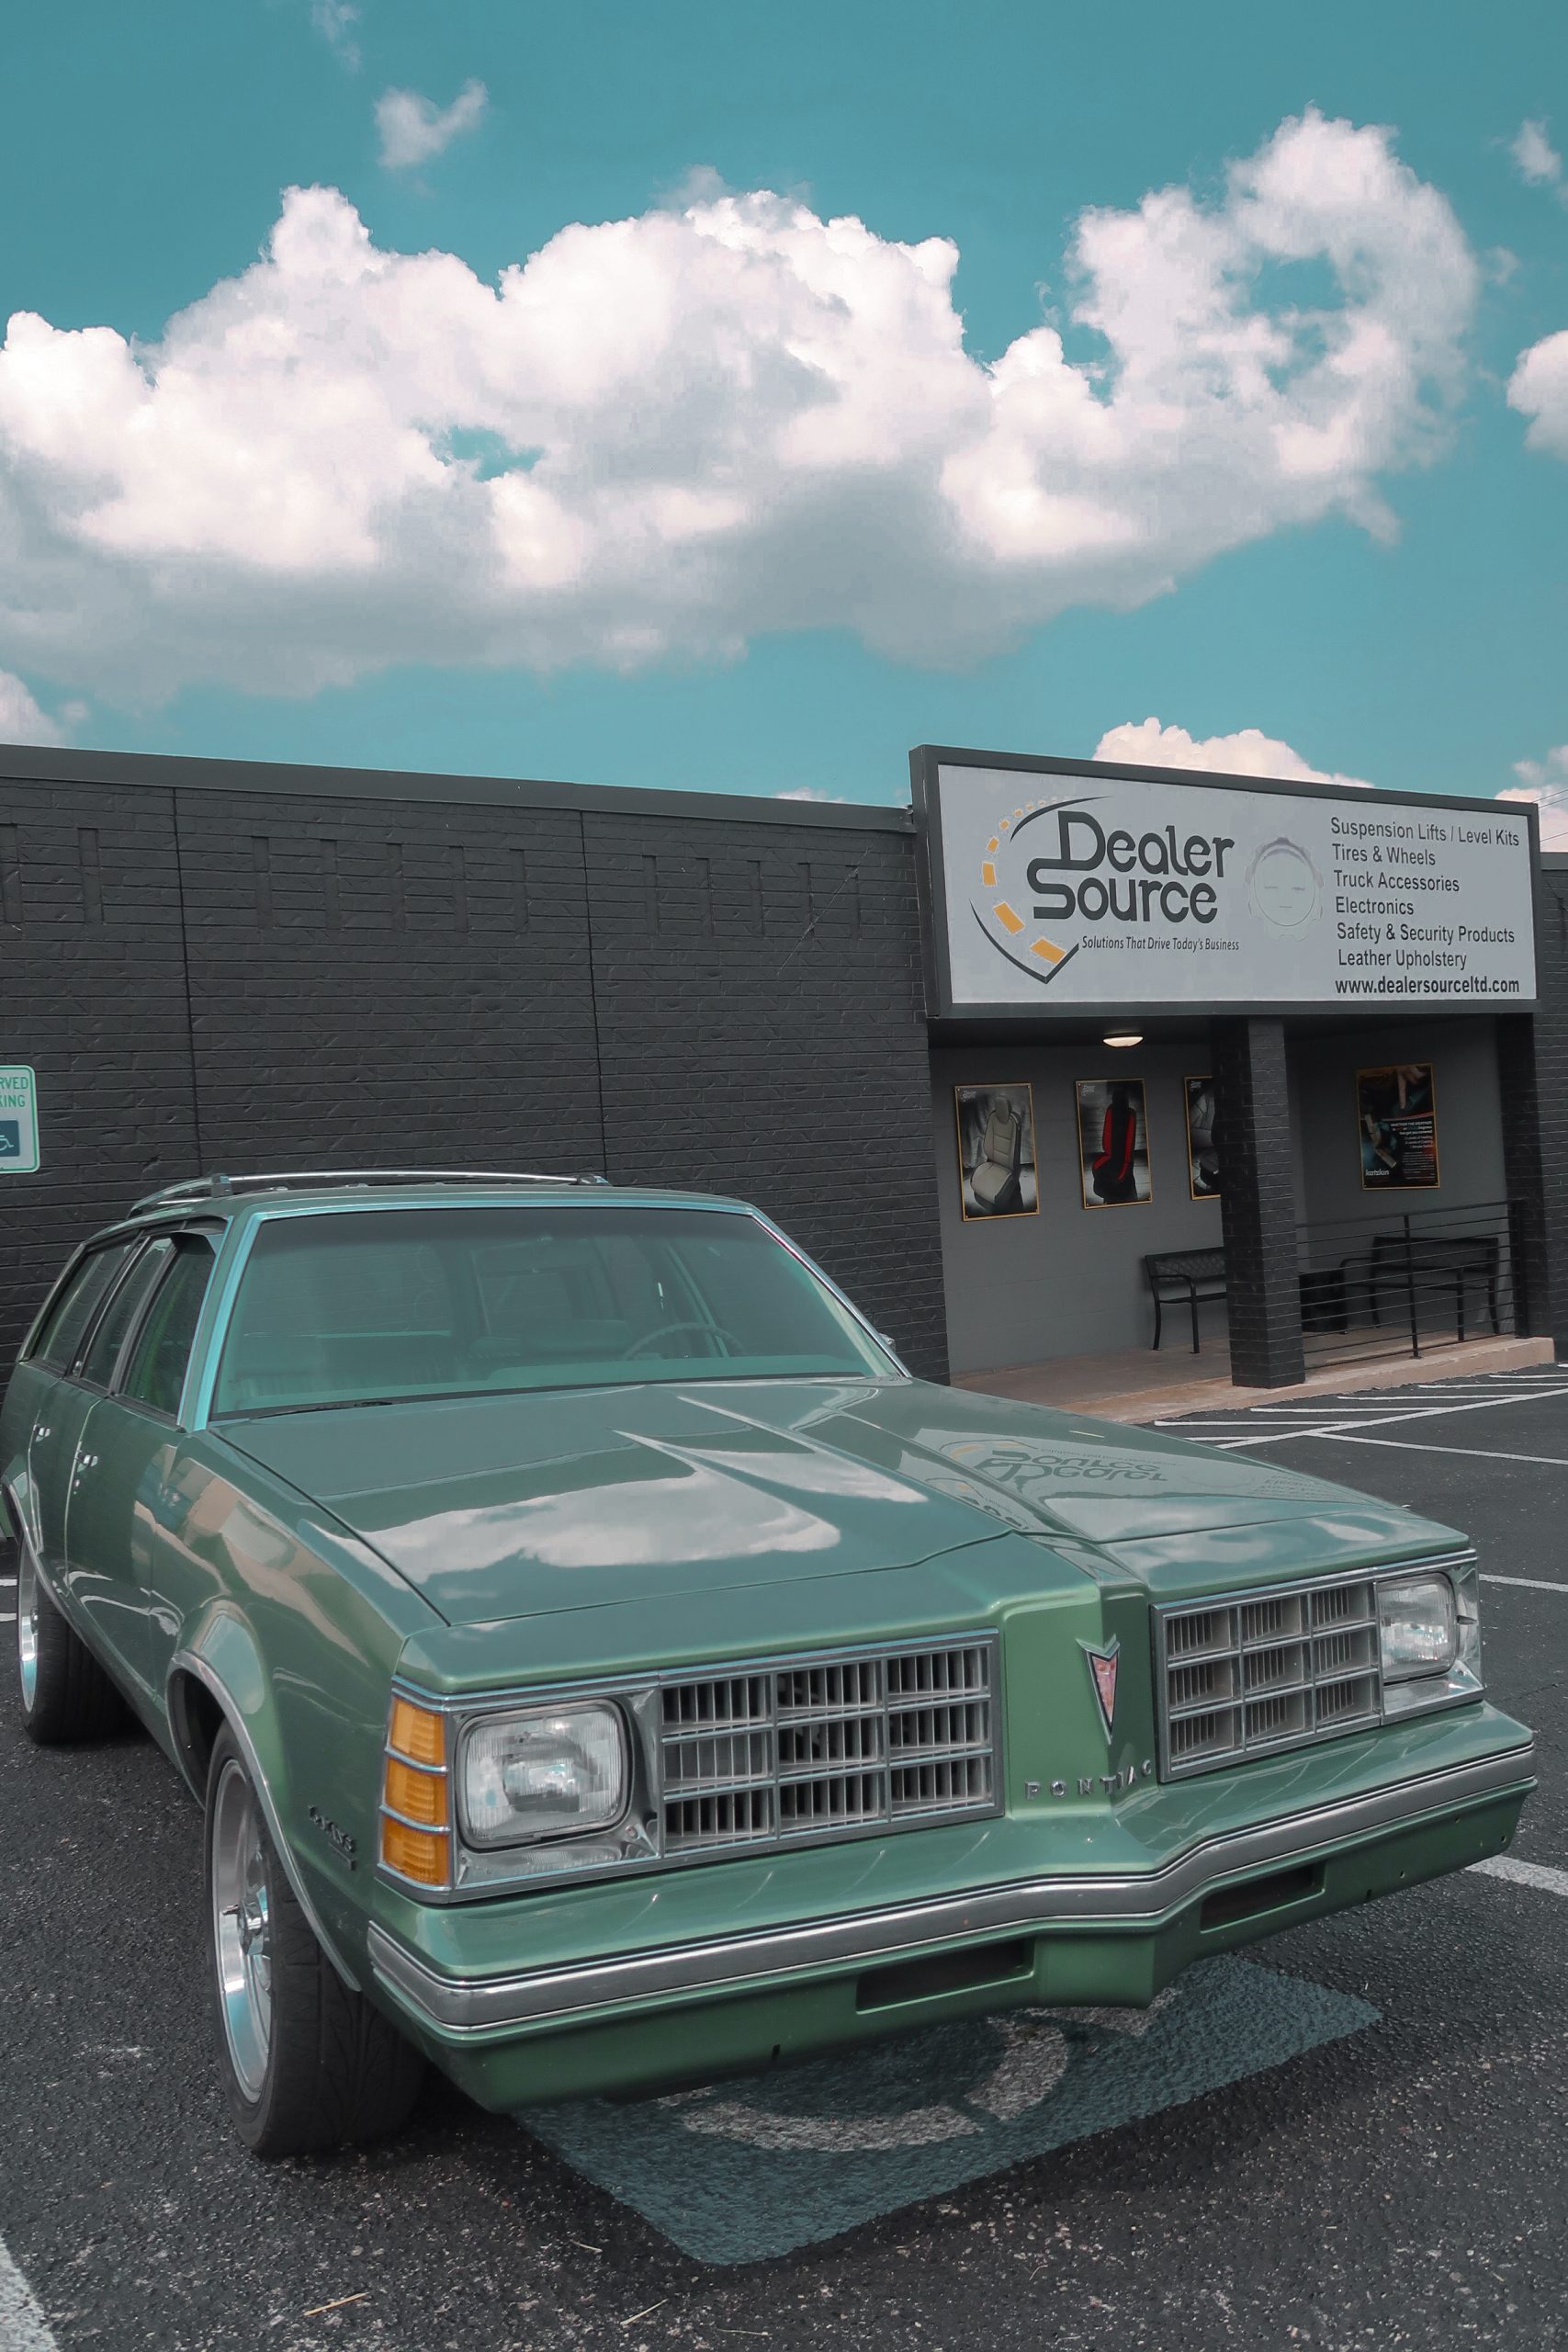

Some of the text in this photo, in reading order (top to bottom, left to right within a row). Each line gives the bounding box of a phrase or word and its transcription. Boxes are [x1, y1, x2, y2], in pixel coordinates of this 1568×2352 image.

[1331, 817, 1414, 840] Suspension
[1417, 823, 1447, 842] Lifts
[1458, 827, 1493, 844] Level
[1495, 829, 1519, 846] Kits
[1056, 810, 1235, 878] Dealer
[1332, 843, 1436, 865] Tires & Wheels
[1026, 857, 1218, 924] Source
[1334, 869, 1460, 892] Truck Accessories
[1336, 896, 1415, 915] Electronics
[1082, 935, 1124, 949] Solutions
[1126, 936, 1146, 950] That
[1147, 937, 1171, 950] Drive
[1205, 939, 1240, 951] Business
[1337, 922, 1515, 945] Safety & Security Products
[1338, 948, 1467, 970] Leather Upholstery
[1335, 976, 1520, 994] www.dealersourceltd.com
[1024, 1758, 1153, 1801] PONTIAC
